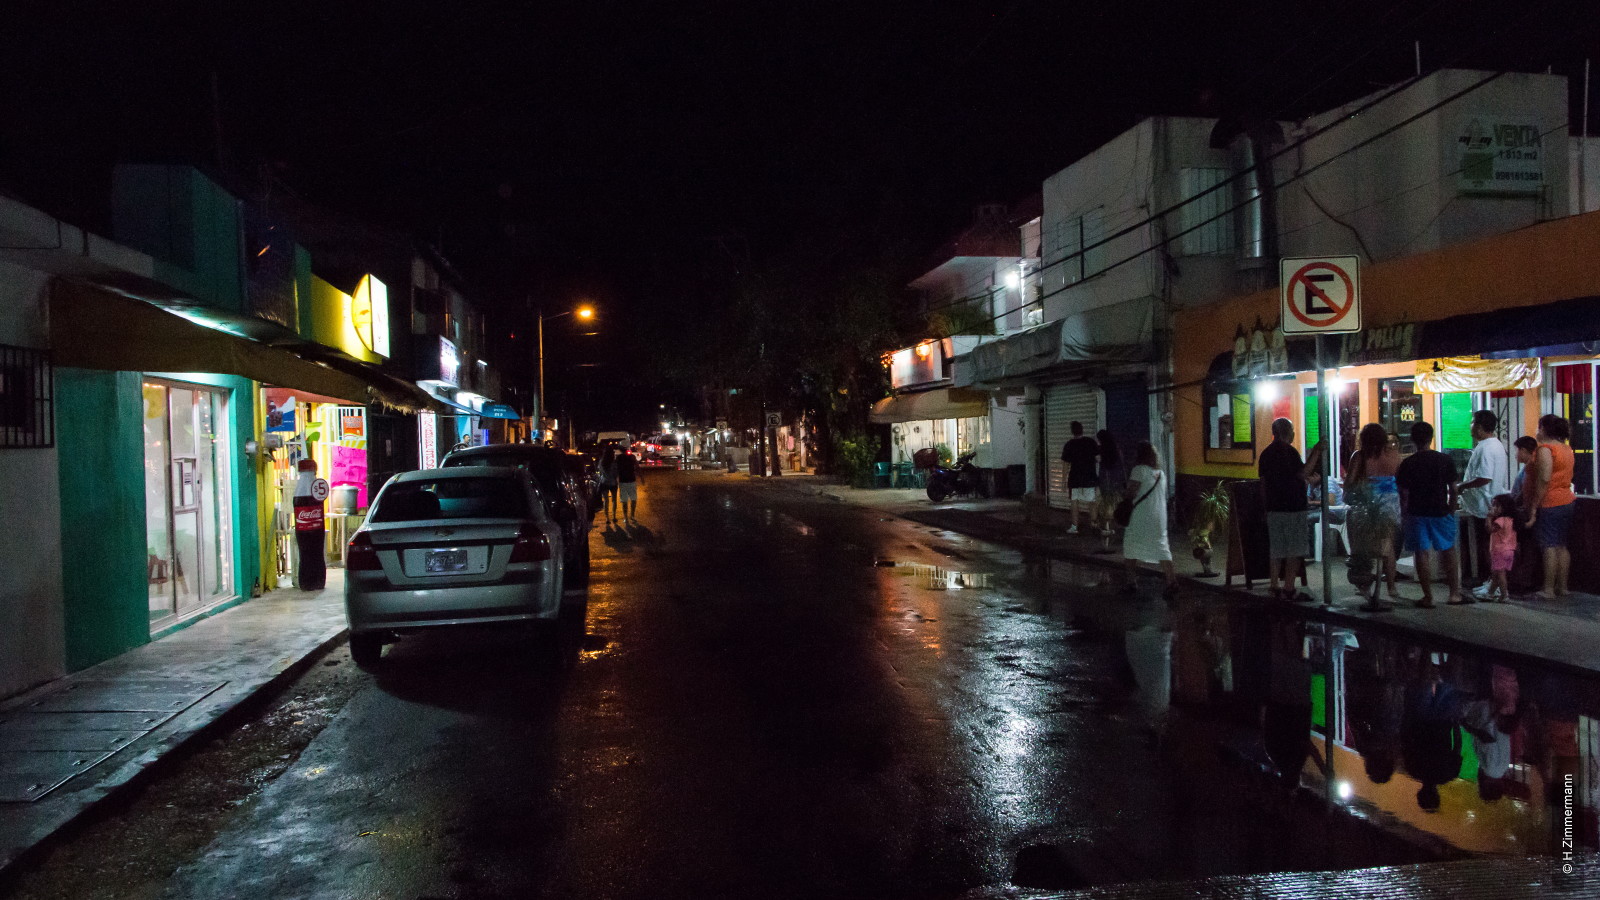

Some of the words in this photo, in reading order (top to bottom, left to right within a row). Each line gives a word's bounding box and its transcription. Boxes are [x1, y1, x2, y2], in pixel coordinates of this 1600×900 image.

[1493, 124, 1541, 147] VENTA
[1305, 274, 1334, 314] E
[313, 482, 326, 496] $5
